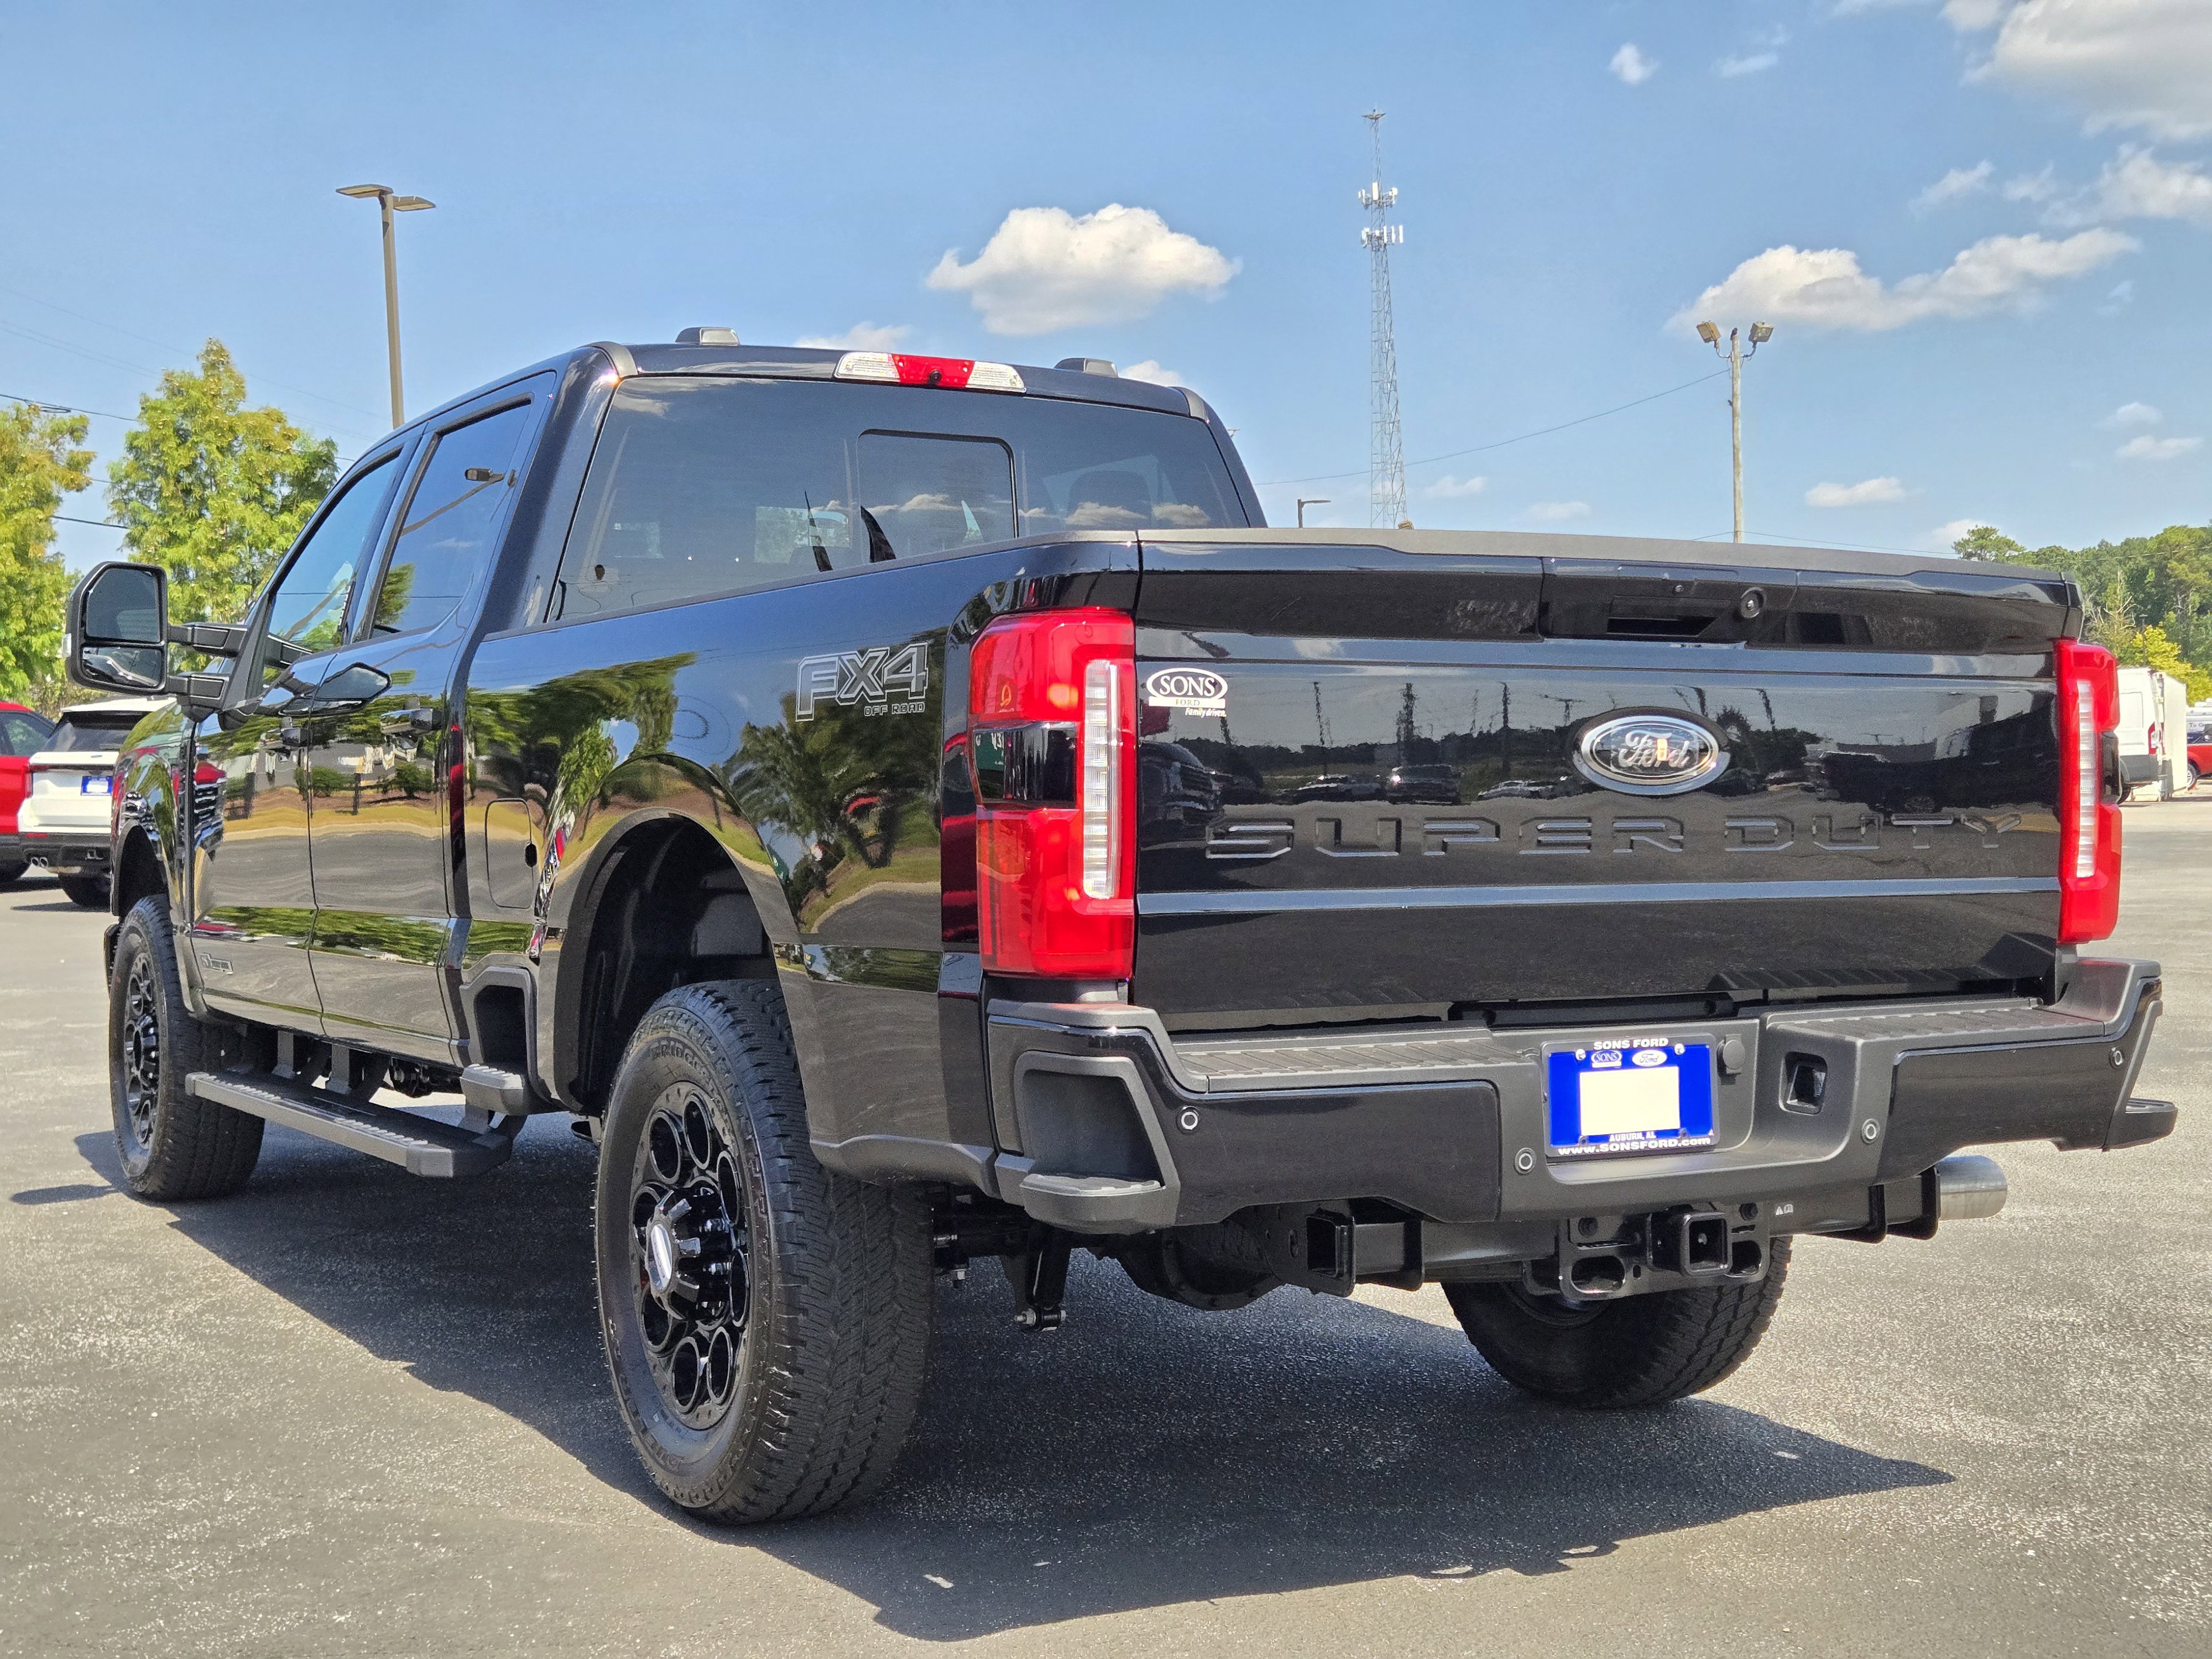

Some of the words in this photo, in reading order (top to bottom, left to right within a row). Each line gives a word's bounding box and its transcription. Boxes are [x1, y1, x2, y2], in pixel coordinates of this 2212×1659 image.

[795, 641, 928, 722] FX4
[1159, 675, 1215, 697] SONS
[864, 705, 888, 717] OFF
[891, 701, 926, 714] ROAD
[1618, 729, 1690, 768] Ford
[1206, 815, 1684, 859] SUPER
[1724, 812, 2022, 853] DUTY
[1593, 1040, 1630, 1050] SONS
[1633, 1037, 1669, 1048] FORD
[1595, 1052, 1618, 1062] SONS
[1640, 1053, 1659, 1063] Ford
[1646, 1131, 1656, 1139] AL
[1558, 1138, 1711, 1156] www.SONSFORD.com
